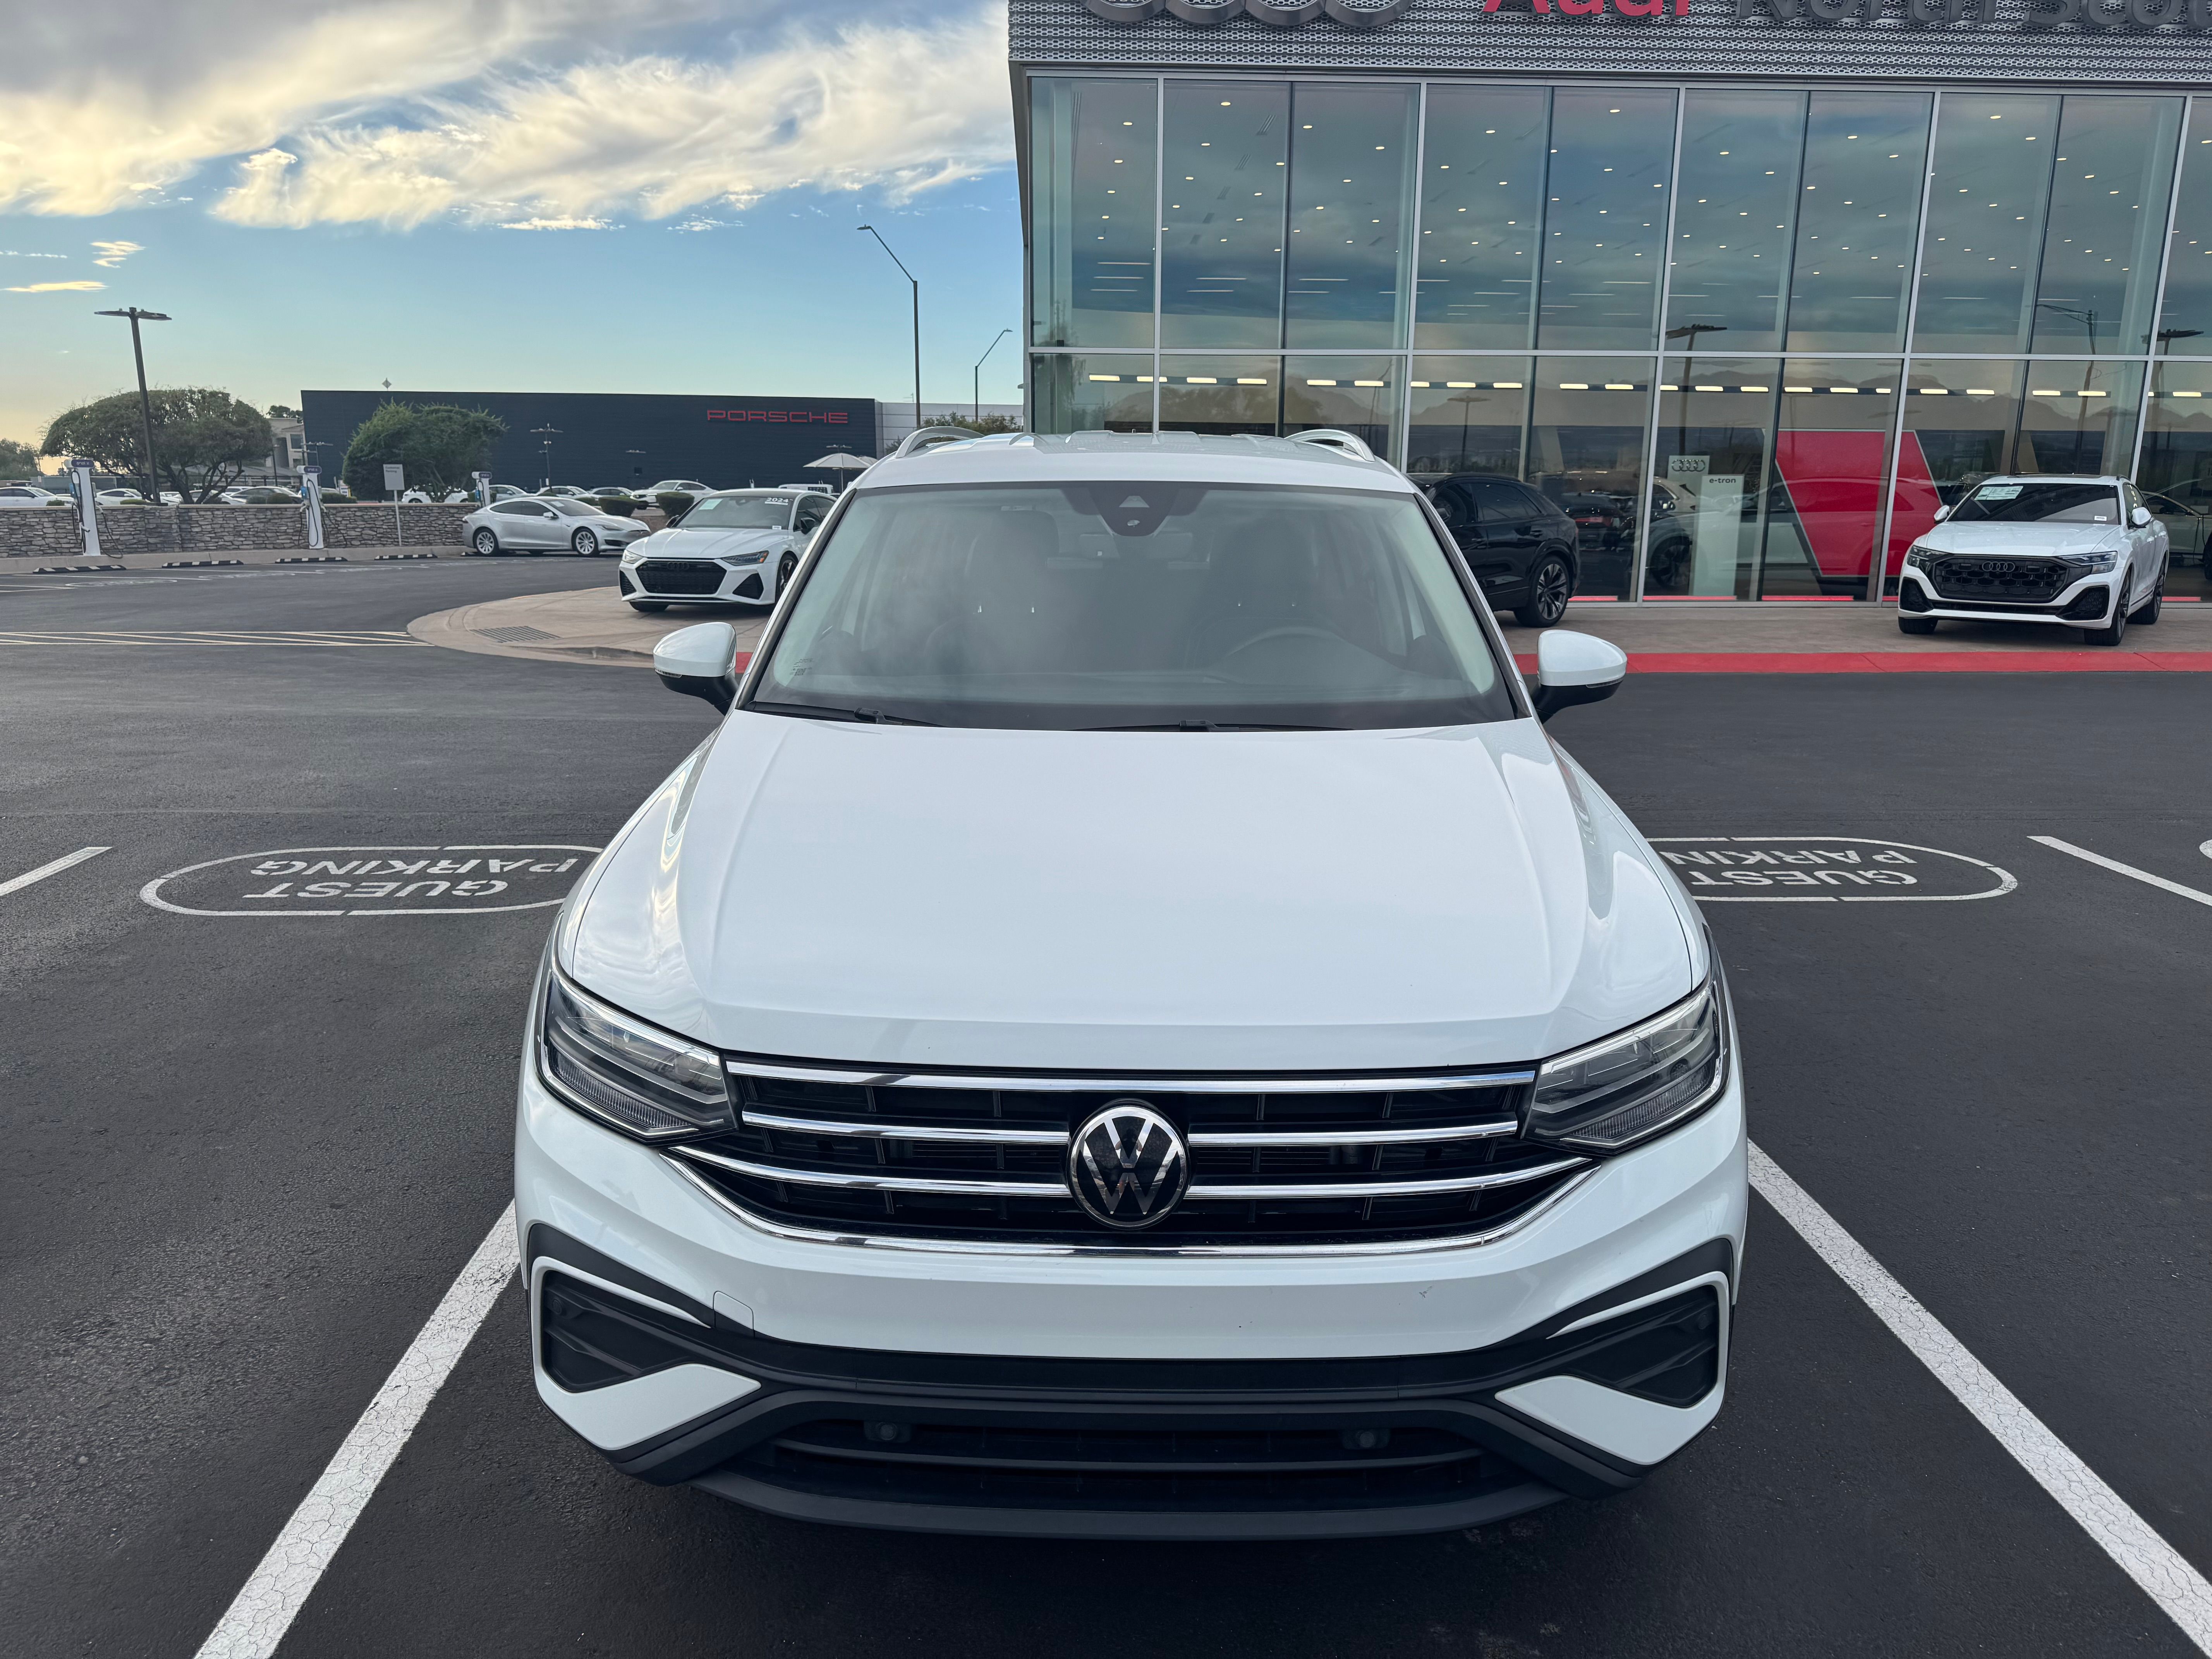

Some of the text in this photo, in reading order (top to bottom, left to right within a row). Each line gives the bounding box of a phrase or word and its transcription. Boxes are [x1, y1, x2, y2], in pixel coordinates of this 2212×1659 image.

[707, 410, 848, 423] PORSCHE
[1659, 850, 1917, 864] PARKIN
[250, 858, 579, 876] PARKING
[1688, 870, 1918, 885] GUEST
[242, 880, 508, 898] GUEST
